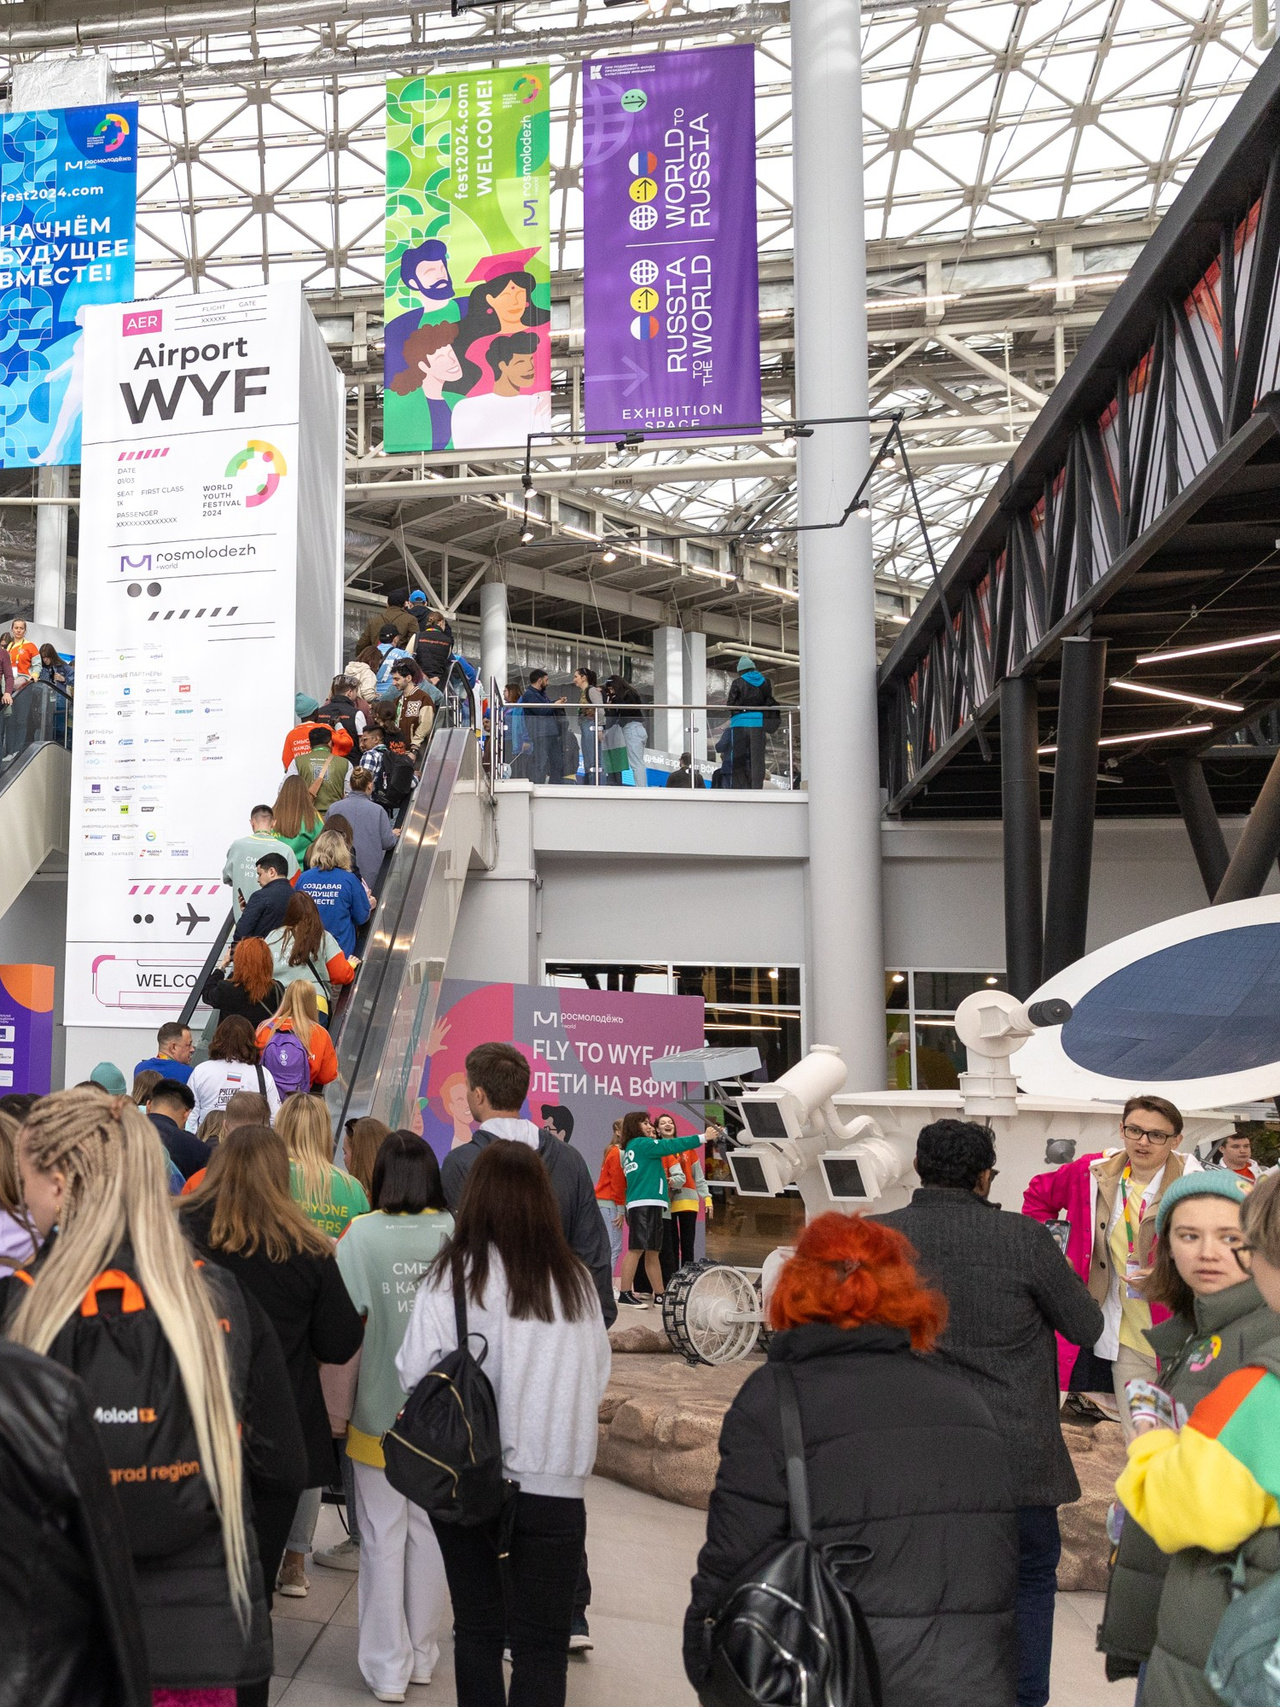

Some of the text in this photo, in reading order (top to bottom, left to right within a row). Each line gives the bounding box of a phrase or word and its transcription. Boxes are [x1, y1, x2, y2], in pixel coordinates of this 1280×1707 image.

[455, 83, 469, 199] fest2024.com
[476, 80, 493, 197] WELCOME!
[520, 114, 532, 197] rosmolodezh
[665, 108, 685, 229] WORLD TO
[689, 112, 710, 228] RUSSIA
[0, 184, 104, 202] fest2024.com
[0, 214, 111, 242] НАЧНЁМ
[0, 238, 128, 267] БУДУЩЕЕ
[238, 300, 256, 308] GATE
[126, 315, 158, 330] AER
[666, 256, 687, 373] RUSSIA
[691, 255, 713, 386] THE WORLD
[133, 337, 248, 370] Airport
[692, 360, 703, 379] TO
[119, 366, 270, 425] WYF
[622, 404, 723, 420] EXHIBITION
[117, 467, 136, 475] DATE
[117, 490, 134, 498] SEAT
[141, 485, 184, 496] FIRST CLASS
[203, 484, 233, 492] WORLD
[203, 492, 231, 500] YOUTH
[203, 500, 241, 508] FESTIVAL
[116, 509, 159, 519] PASSENGER
[156, 544, 256, 562] rosmolodezh
[293, 738, 310, 746] СМЫС
[314, 898, 335, 906] МЕСТЕ
[136, 974, 198, 988] WELCO
[561, 1012, 624, 1024] росмолодёжь
[533, 1039, 654, 1065] FLY TO WYF
[532, 1072, 677, 1099] ЛЕТИ НА ВФМ
[382, 1282, 391, 1294] В
[151, 1459, 200, 1483] region
